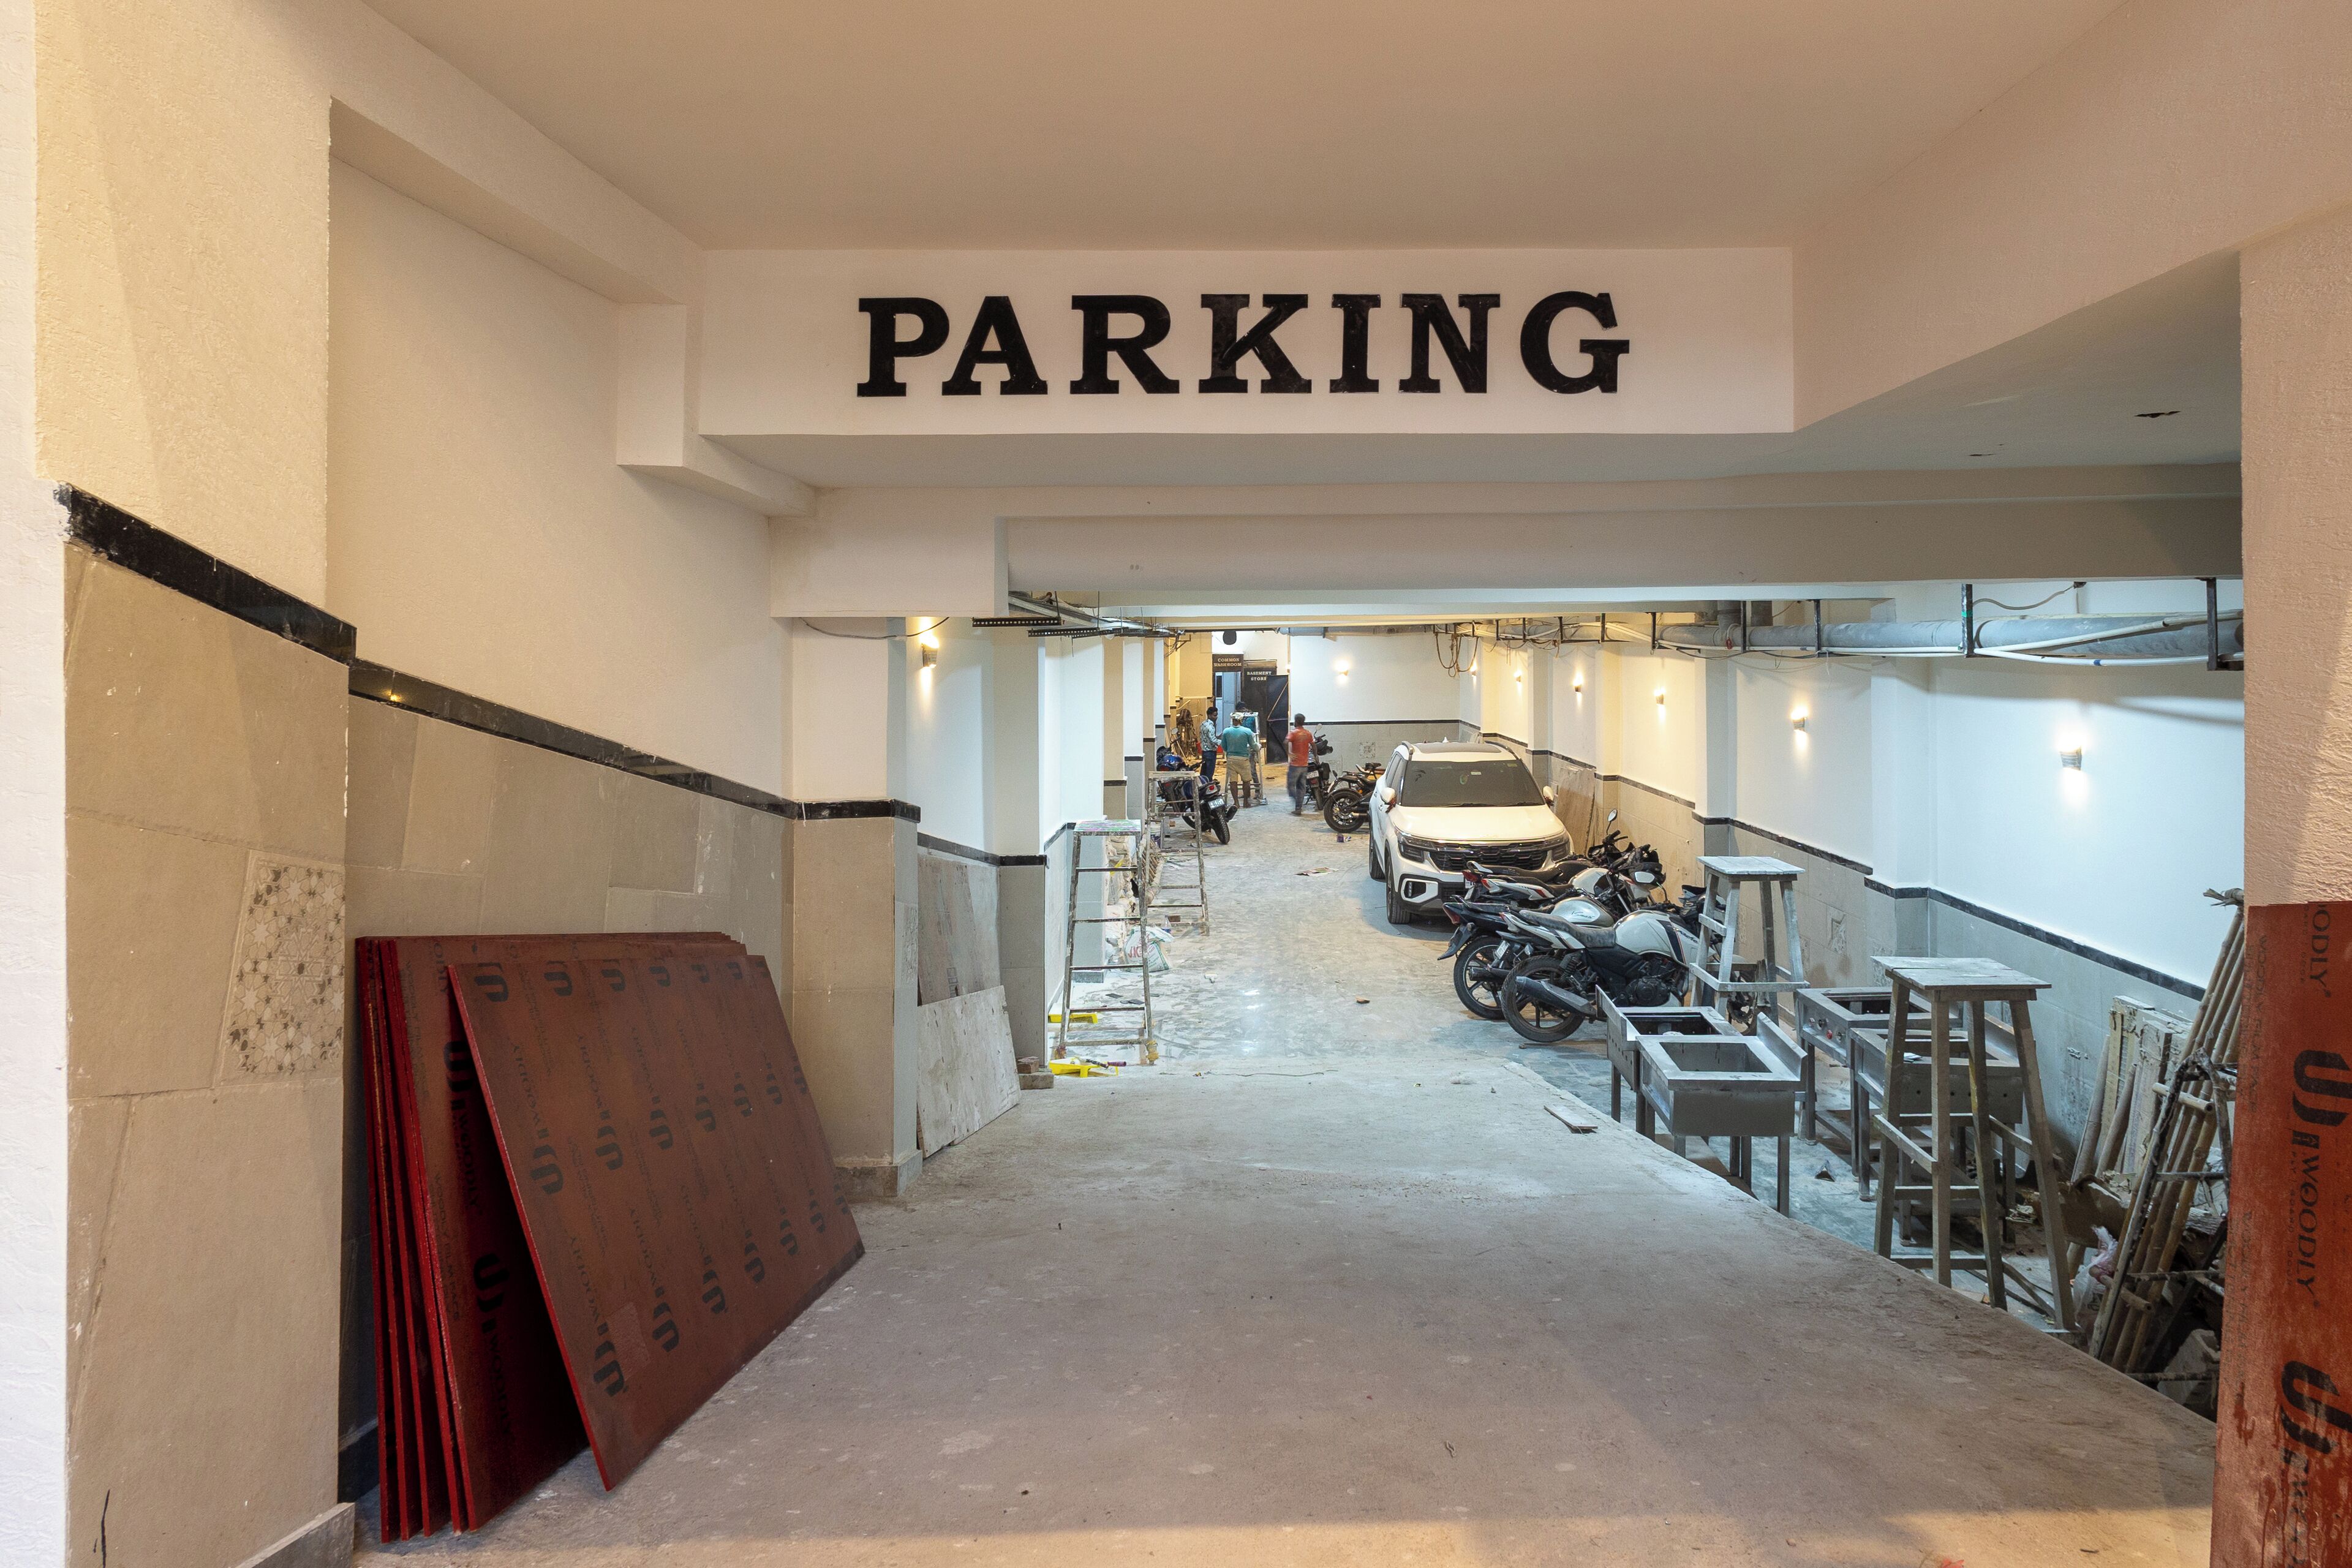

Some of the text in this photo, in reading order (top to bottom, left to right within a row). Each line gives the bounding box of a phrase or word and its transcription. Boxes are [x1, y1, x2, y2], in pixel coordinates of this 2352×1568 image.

[857, 290, 1630, 396] PARKING
[2309, 905, 2331, 987] ODLY
[2296, 1155, 2320, 1295] WOODLY
